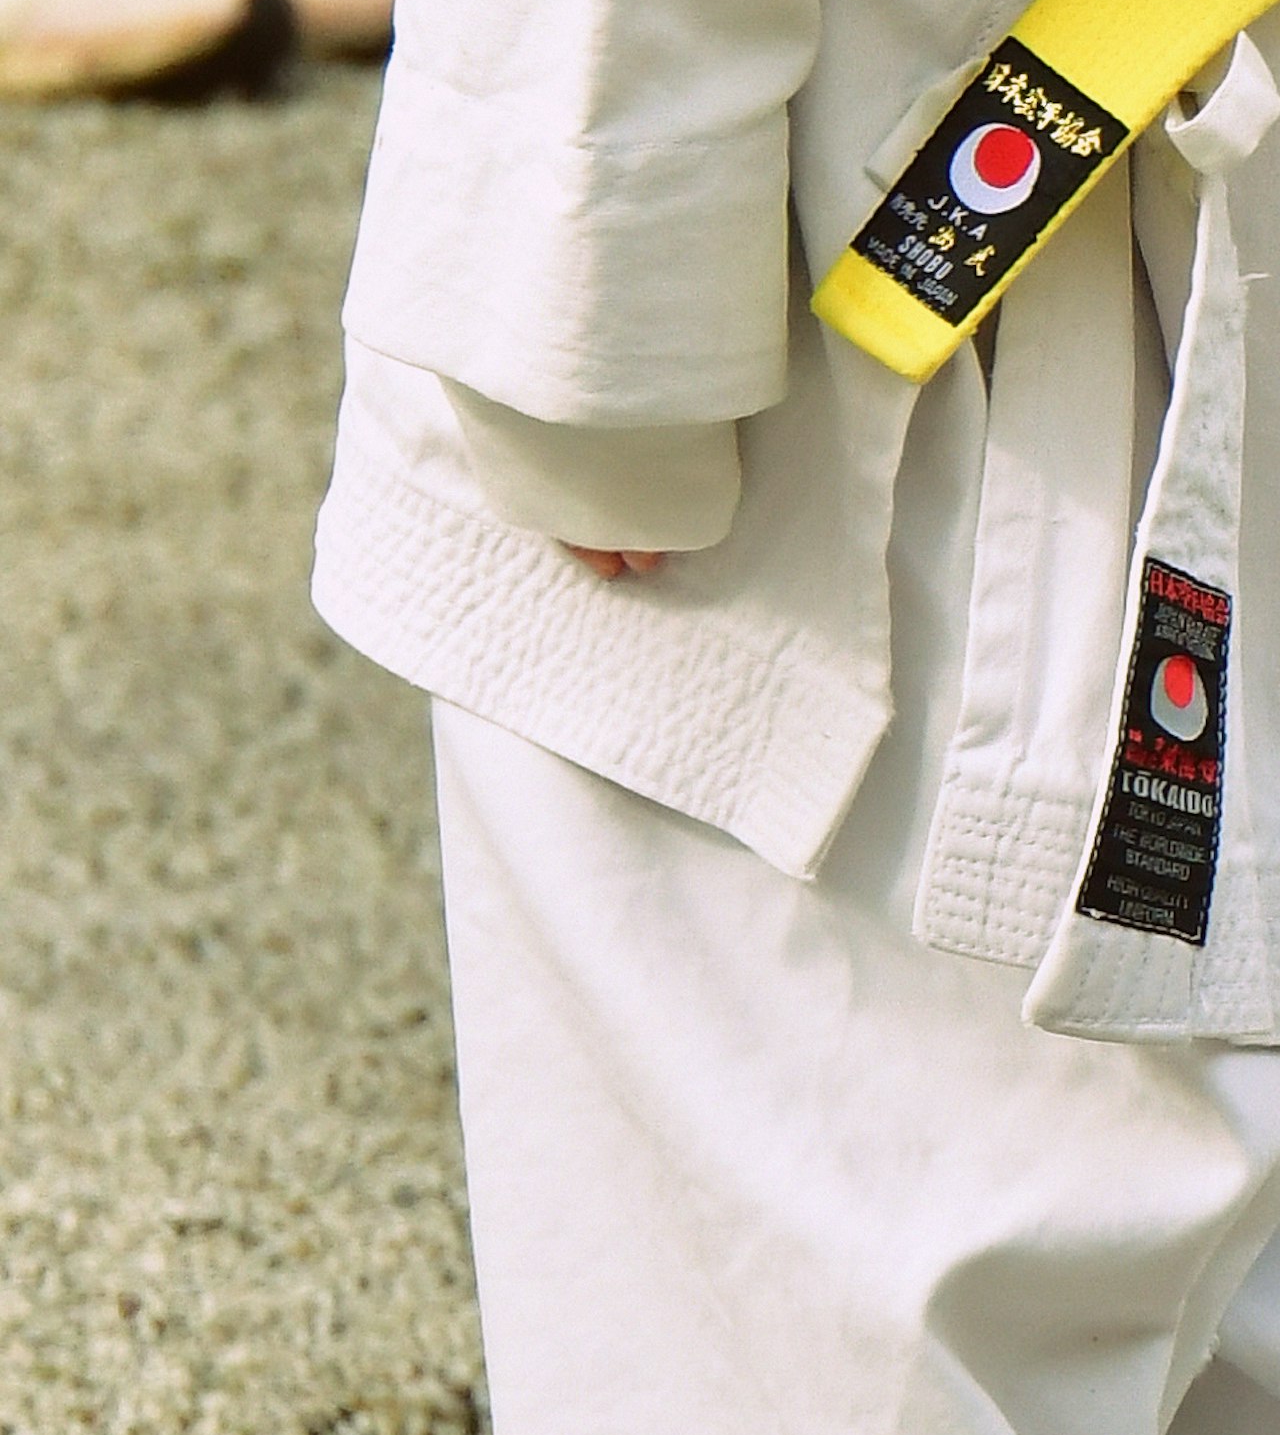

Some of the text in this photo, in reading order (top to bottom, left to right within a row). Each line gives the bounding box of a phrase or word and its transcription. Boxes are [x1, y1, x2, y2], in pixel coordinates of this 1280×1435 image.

[927, 196, 987, 240] J.K.A
[898, 235, 954, 280] SHOBU
[917, 277, 958, 305] JAPAN
[1125, 848, 1191, 882] STANDARD
